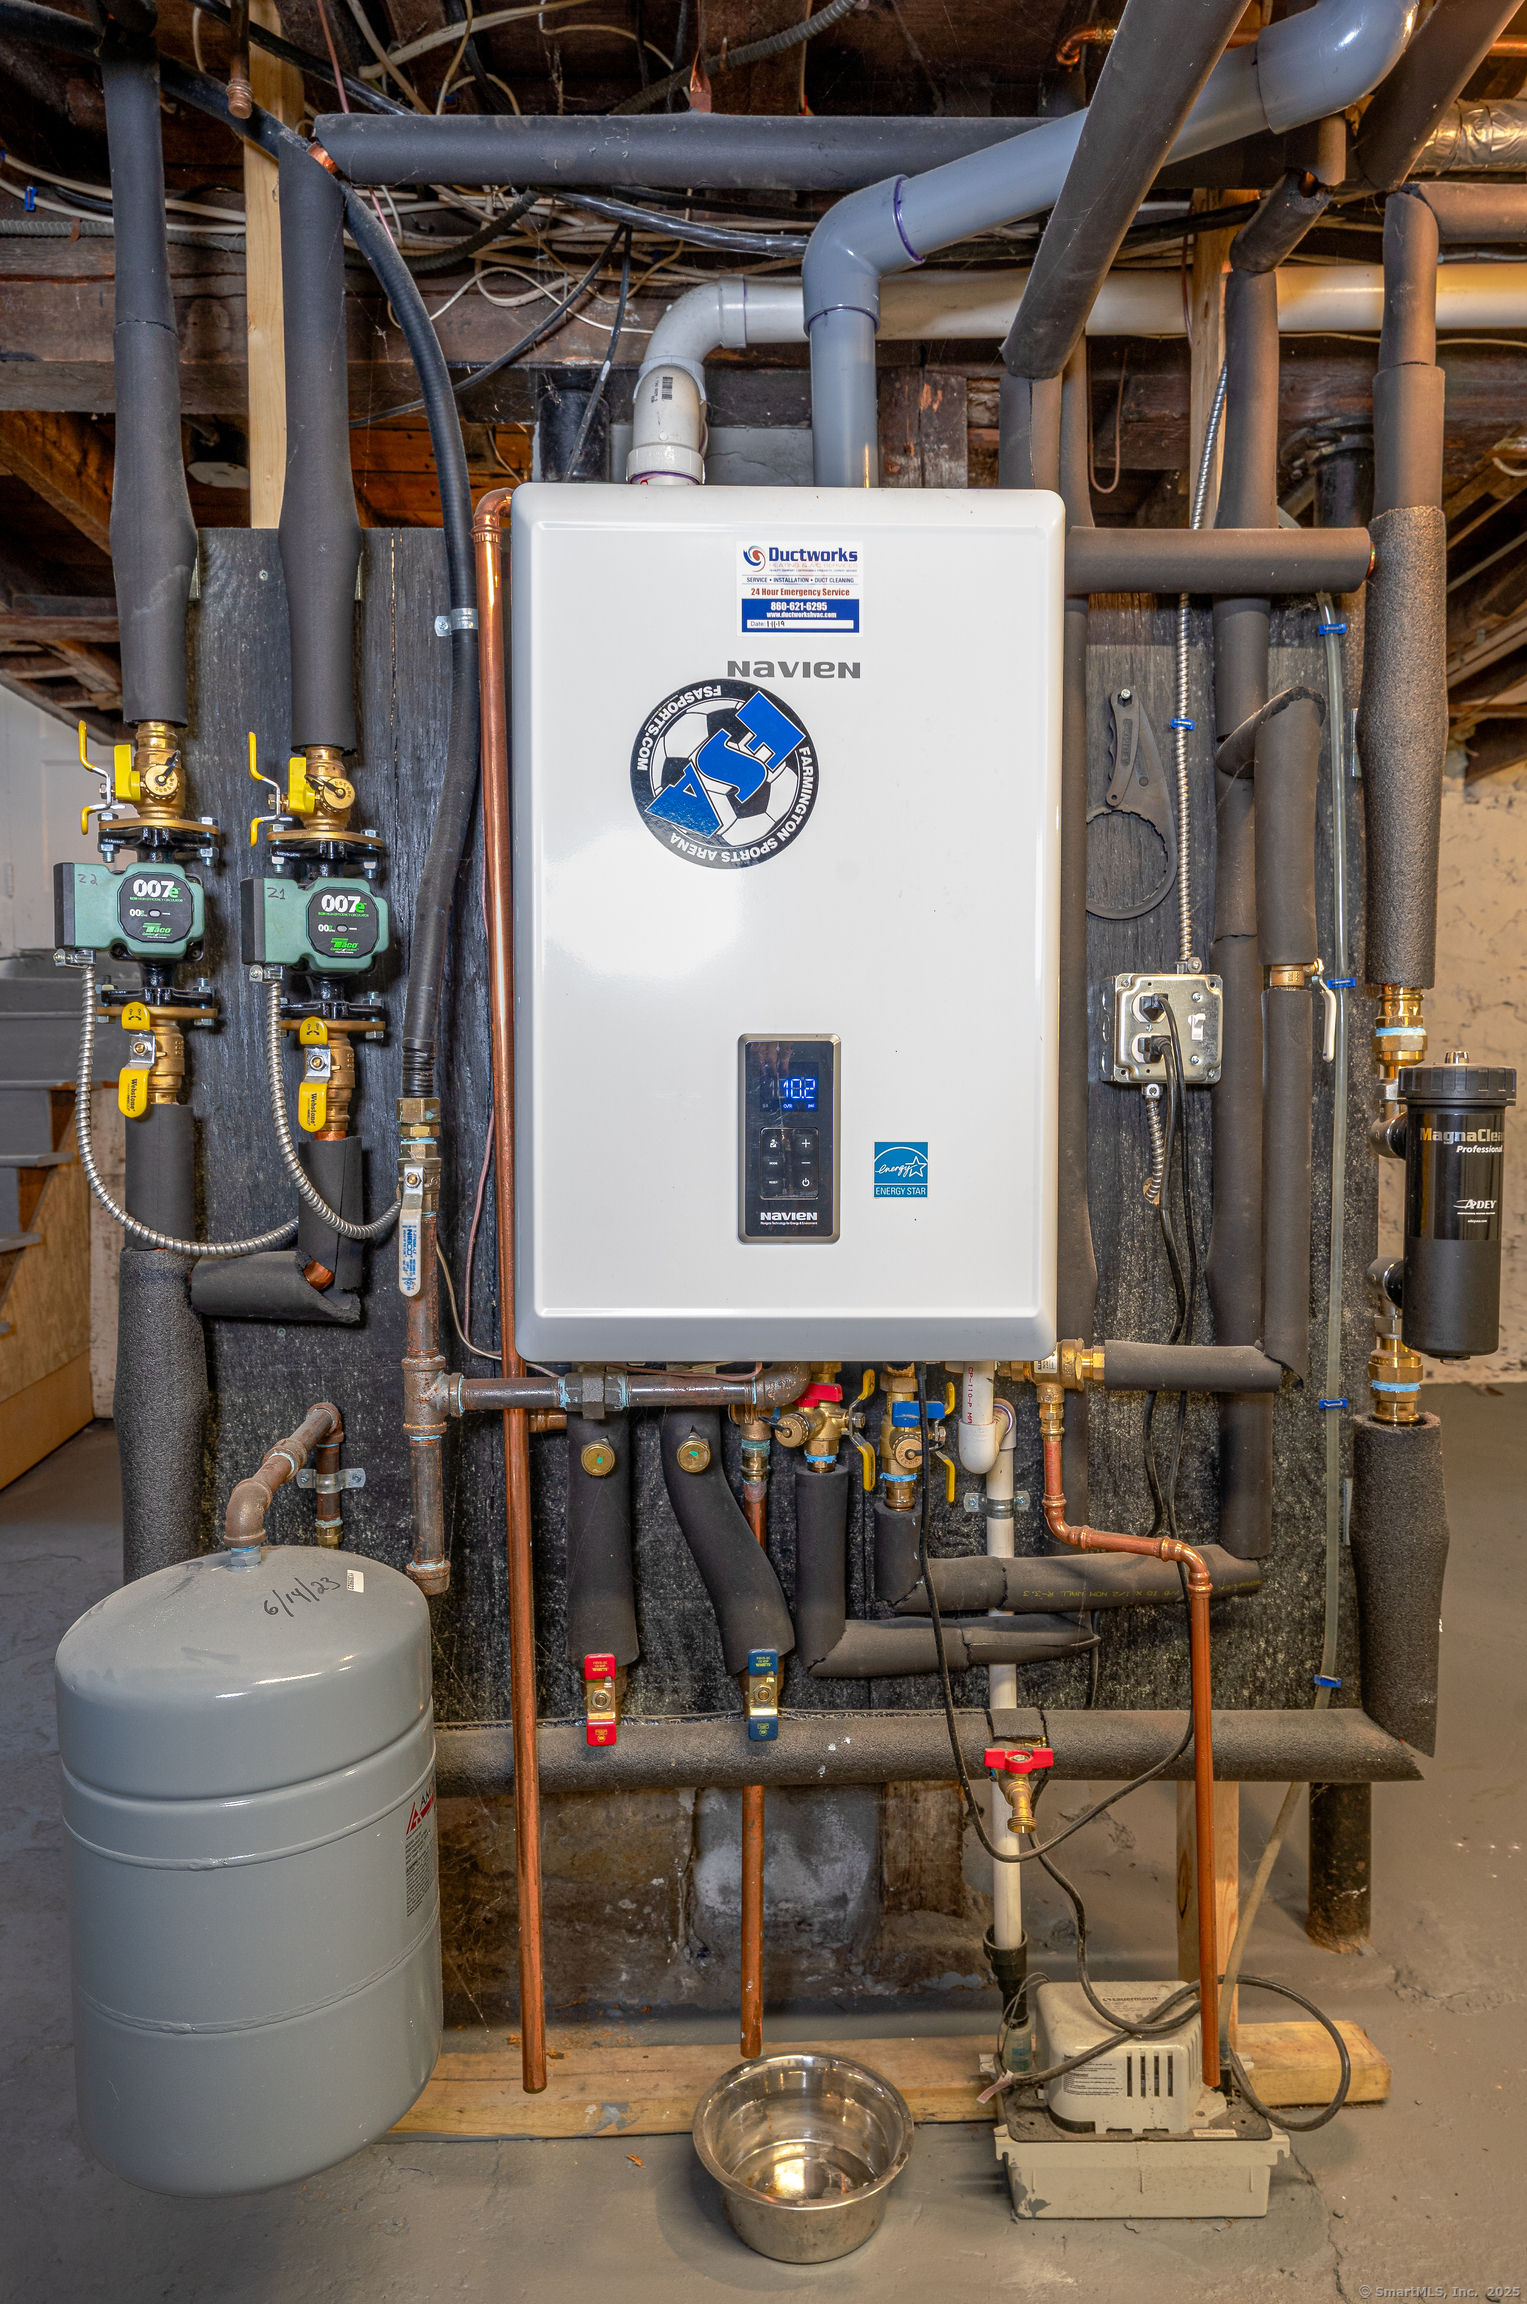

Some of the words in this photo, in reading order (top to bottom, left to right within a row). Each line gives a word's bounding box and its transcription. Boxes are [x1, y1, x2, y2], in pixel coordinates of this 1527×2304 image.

[768, 546, 858, 562] Ductworks
[781, 588, 821, 597] Emergency
[822, 588, 850, 596] Service
[770, 602, 827, 611] 860-621-6295
[636, 684, 722, 771] FSASPORTS.COM
[776, 746, 814, 842] FARMINGTON
[670, 832, 718, 862] ARENA
[721, 836, 778, 862] SPORTS
[1456, 1145, 1502, 1153] Professional
[876, 1187, 906, 1195] ENERGY
[907, 1187, 926, 1195] STAR
[263, 1576, 342, 1618] 6/14/23
